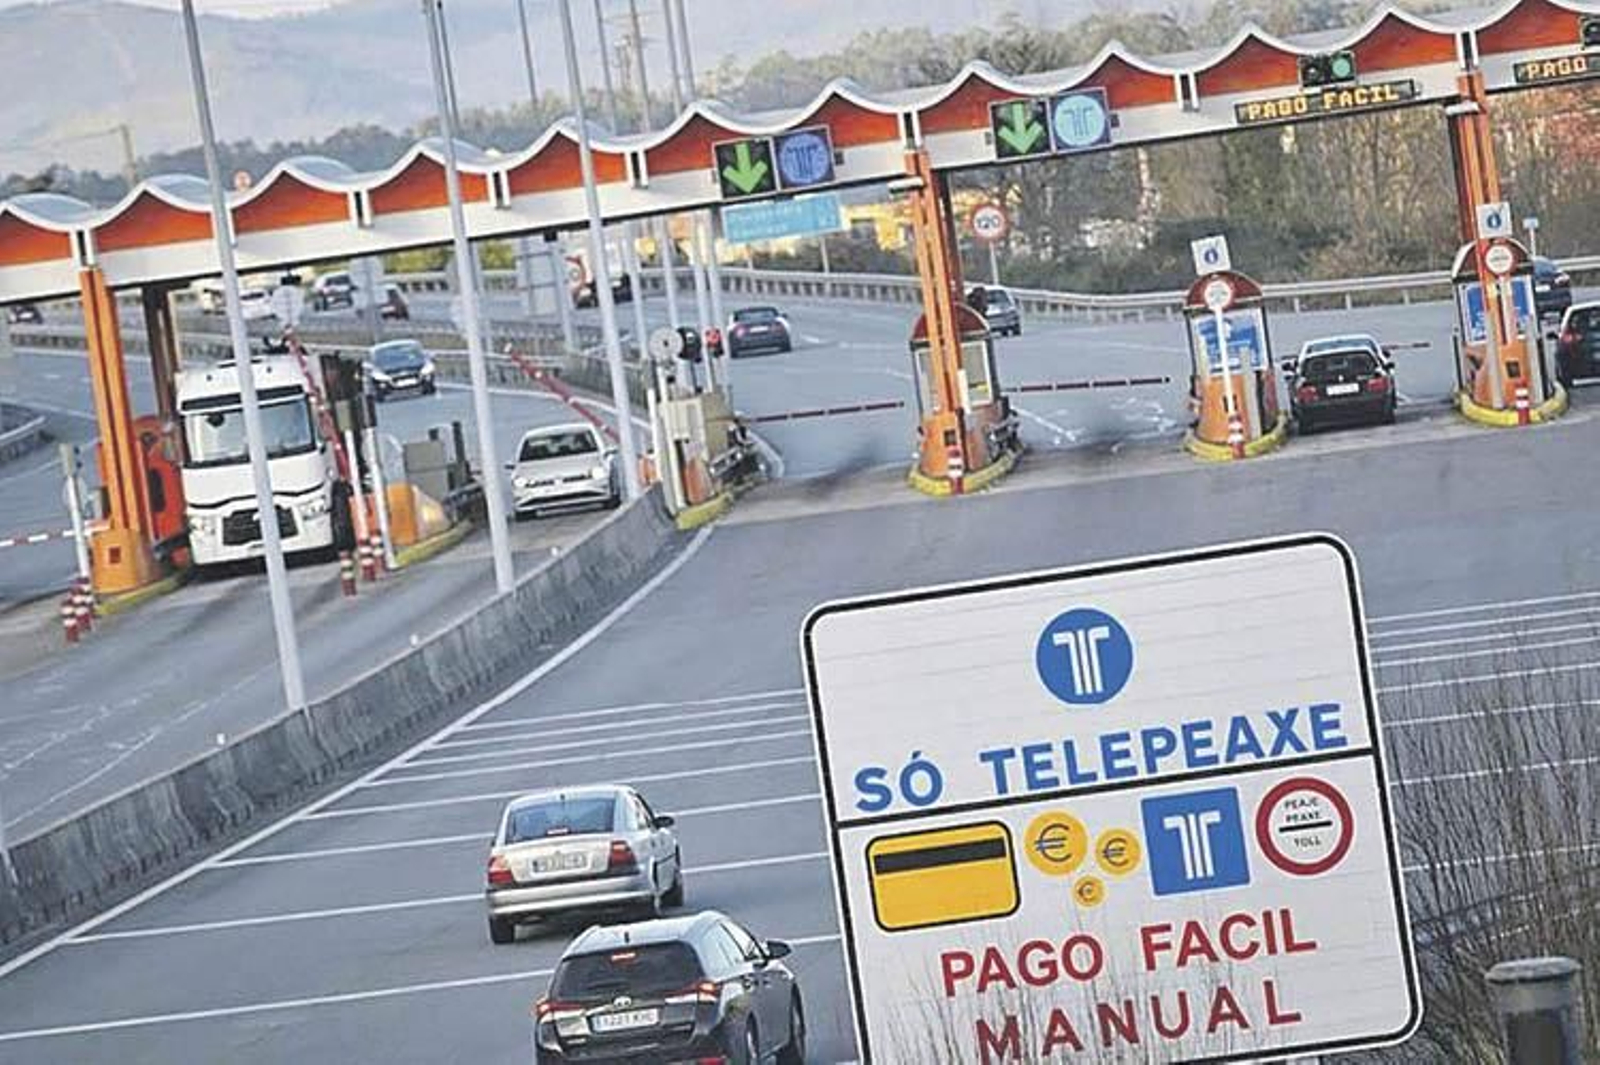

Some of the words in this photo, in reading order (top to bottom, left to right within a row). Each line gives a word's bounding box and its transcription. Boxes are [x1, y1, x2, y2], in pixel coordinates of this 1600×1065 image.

[1248, 94, 1308, 120] PAGO
[1323, 84, 1399, 109] FACIL
[1526, 56, 1587, 79] PAGO
[853, 751, 943, 812] SÓ
[979, 703, 1348, 795] TELEPEAXE
[940, 934, 1102, 997] PAGO
[1141, 908, 1317, 971] FACIL
[976, 980, 1302, 1065] MANUAL
